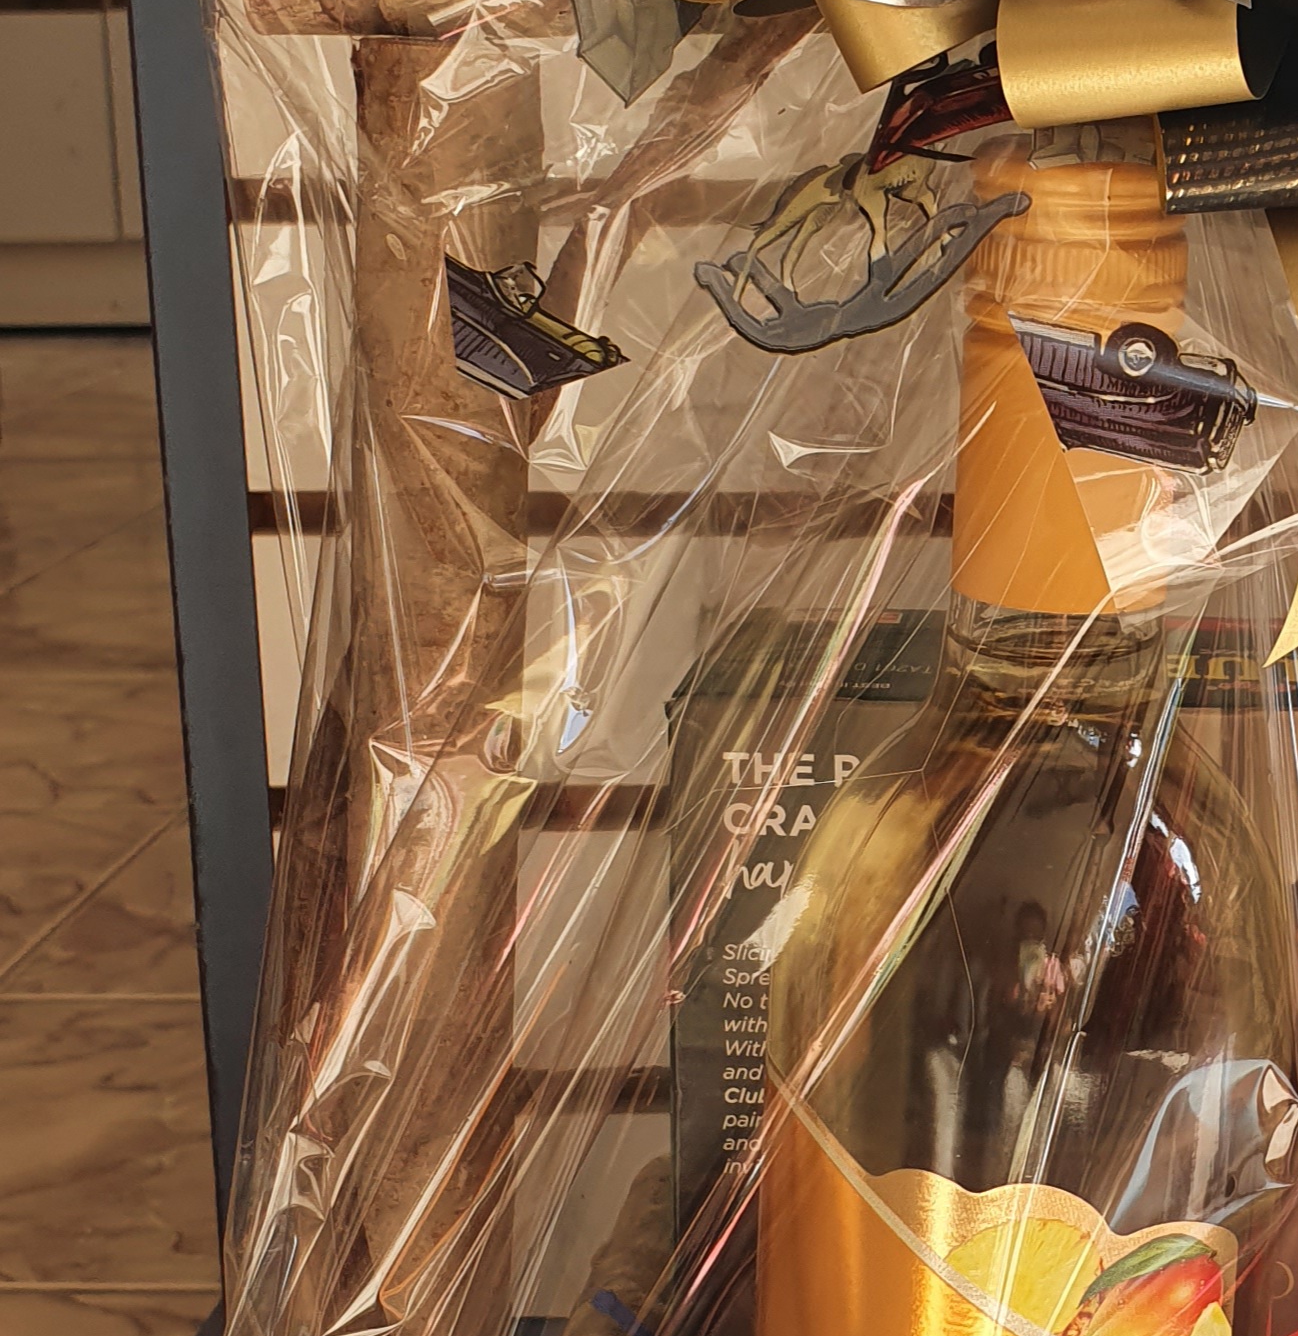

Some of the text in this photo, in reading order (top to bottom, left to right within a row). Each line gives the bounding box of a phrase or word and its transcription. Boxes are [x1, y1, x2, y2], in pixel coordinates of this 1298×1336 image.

[722, 751, 815, 786] THE
[722, 968, 770, 987] Spre
[722, 992, 753, 1009] No
[724, 1016, 768, 1033] with
[722, 1064, 764, 1081] and
